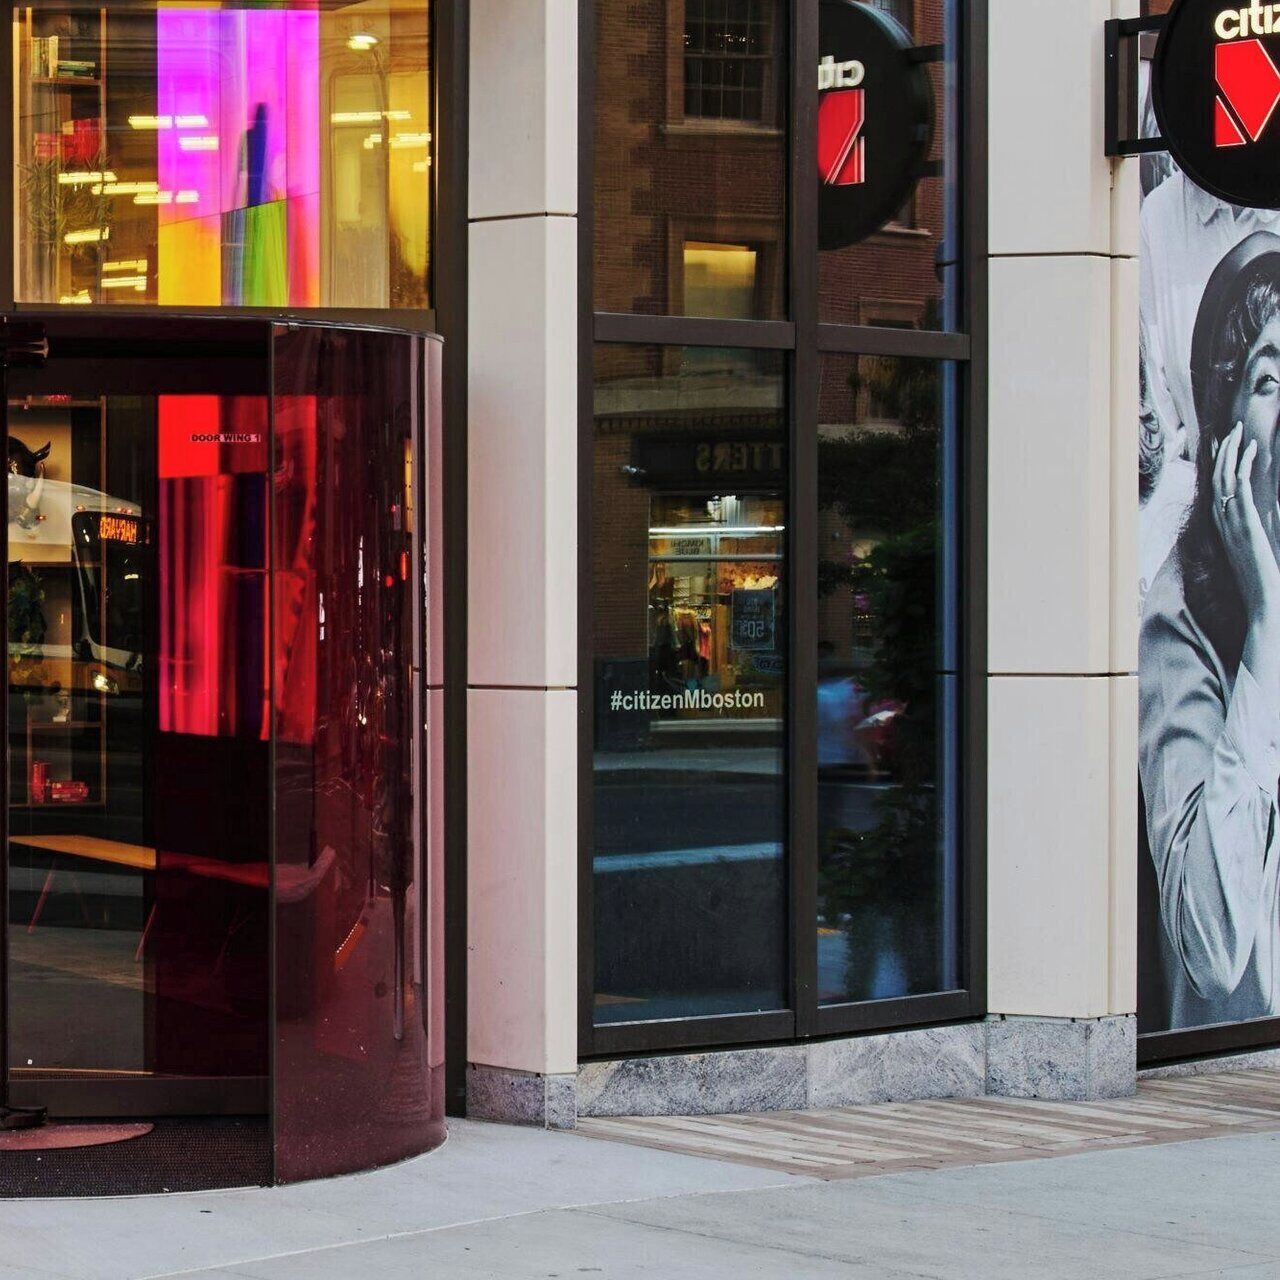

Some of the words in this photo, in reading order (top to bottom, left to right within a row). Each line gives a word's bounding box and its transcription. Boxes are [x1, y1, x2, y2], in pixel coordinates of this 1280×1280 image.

[191, 434, 220, 442] DOOR
[224, 433, 252, 442] WING
[610, 689, 764, 711] #citizenMboston
